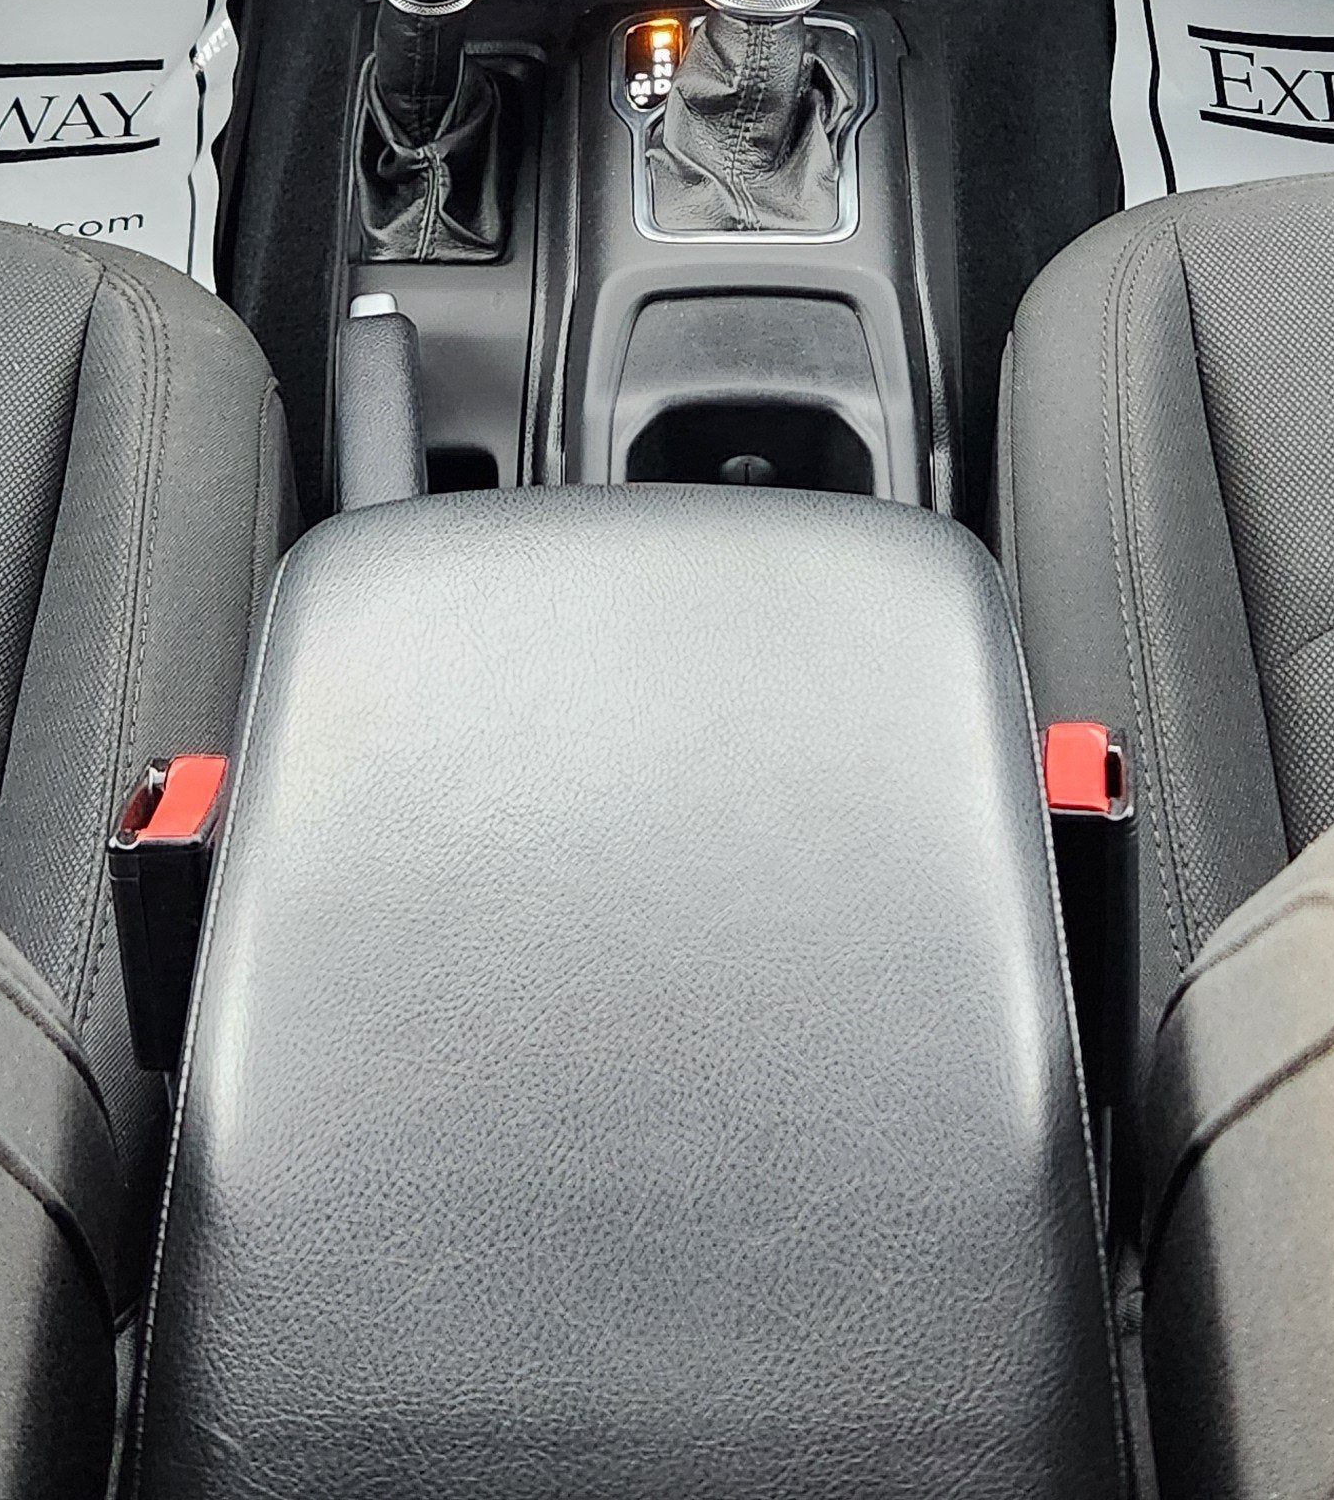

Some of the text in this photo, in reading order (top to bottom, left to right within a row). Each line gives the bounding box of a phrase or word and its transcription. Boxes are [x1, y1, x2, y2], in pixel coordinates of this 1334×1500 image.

[654, 48, 671, 63] R
[654, 63, 672, 78] N
[630, 80, 651, 97] M
[654, 79, 672, 95] D
